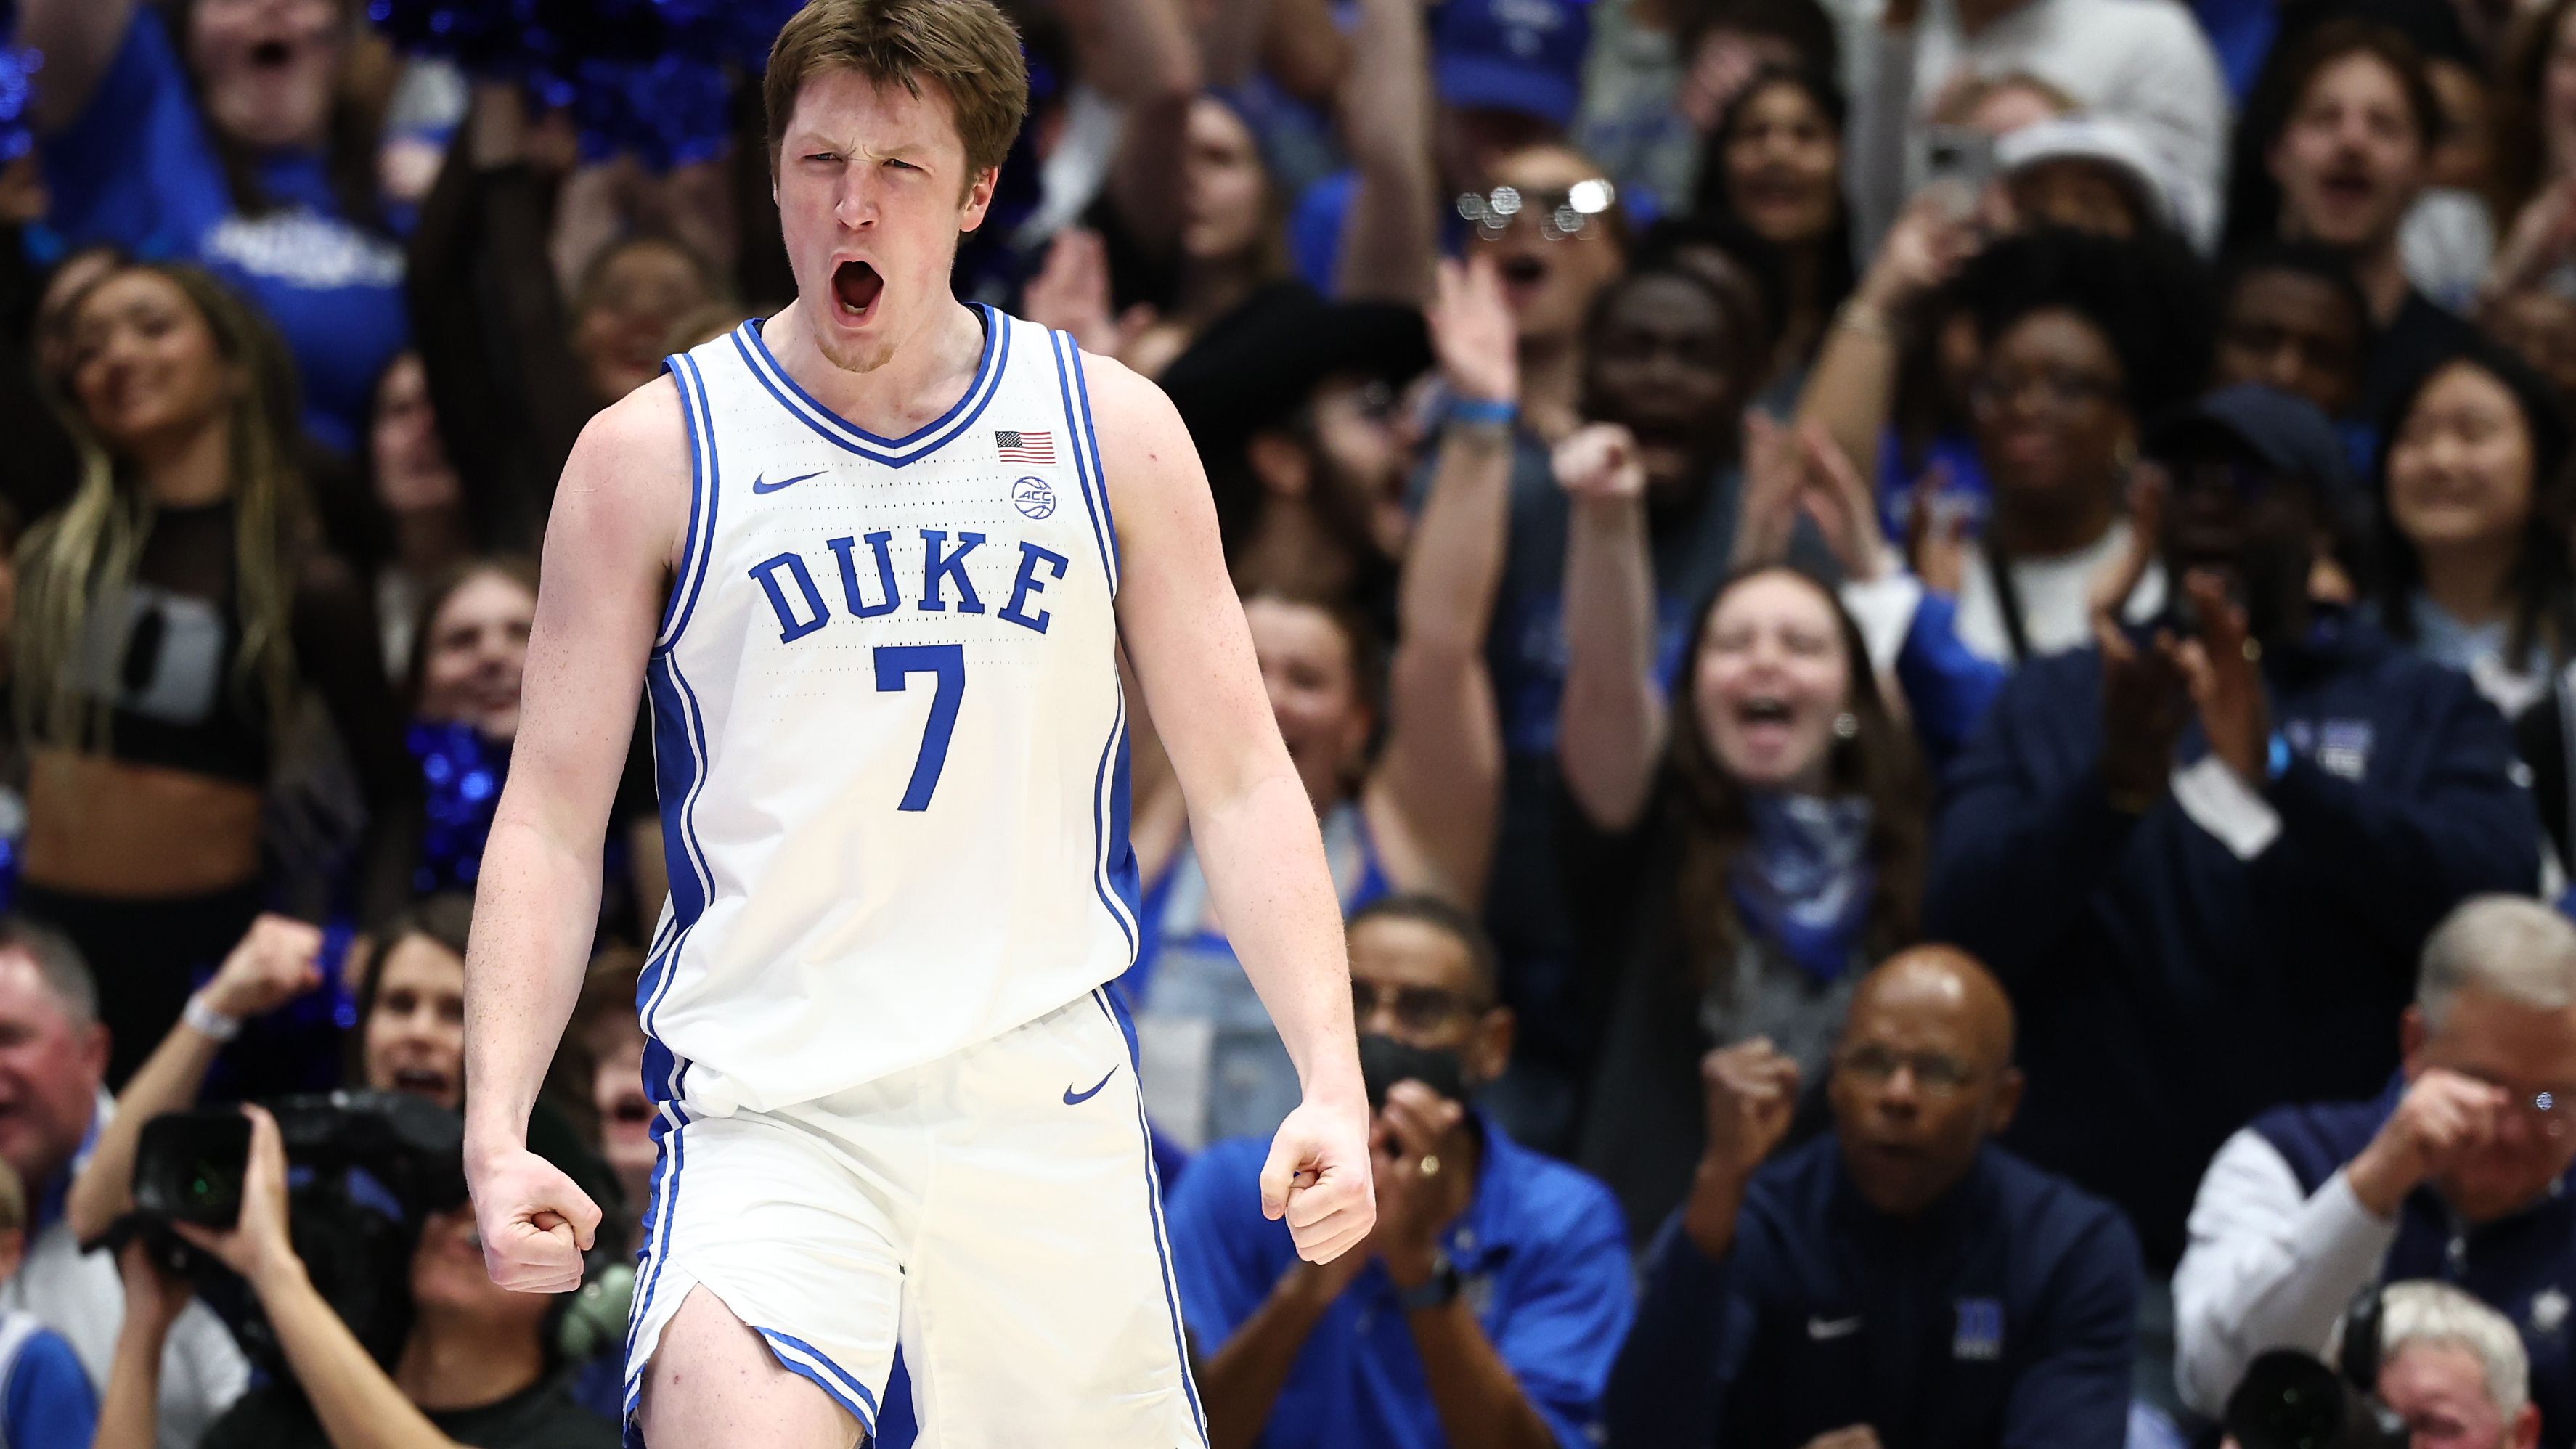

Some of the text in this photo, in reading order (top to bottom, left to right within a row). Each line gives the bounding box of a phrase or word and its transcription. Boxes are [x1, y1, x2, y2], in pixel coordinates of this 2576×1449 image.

[1019, 491, 1051, 501] ACC
[748, 529, 1069, 644] DUKE
[873, 644, 965, 812] 7
